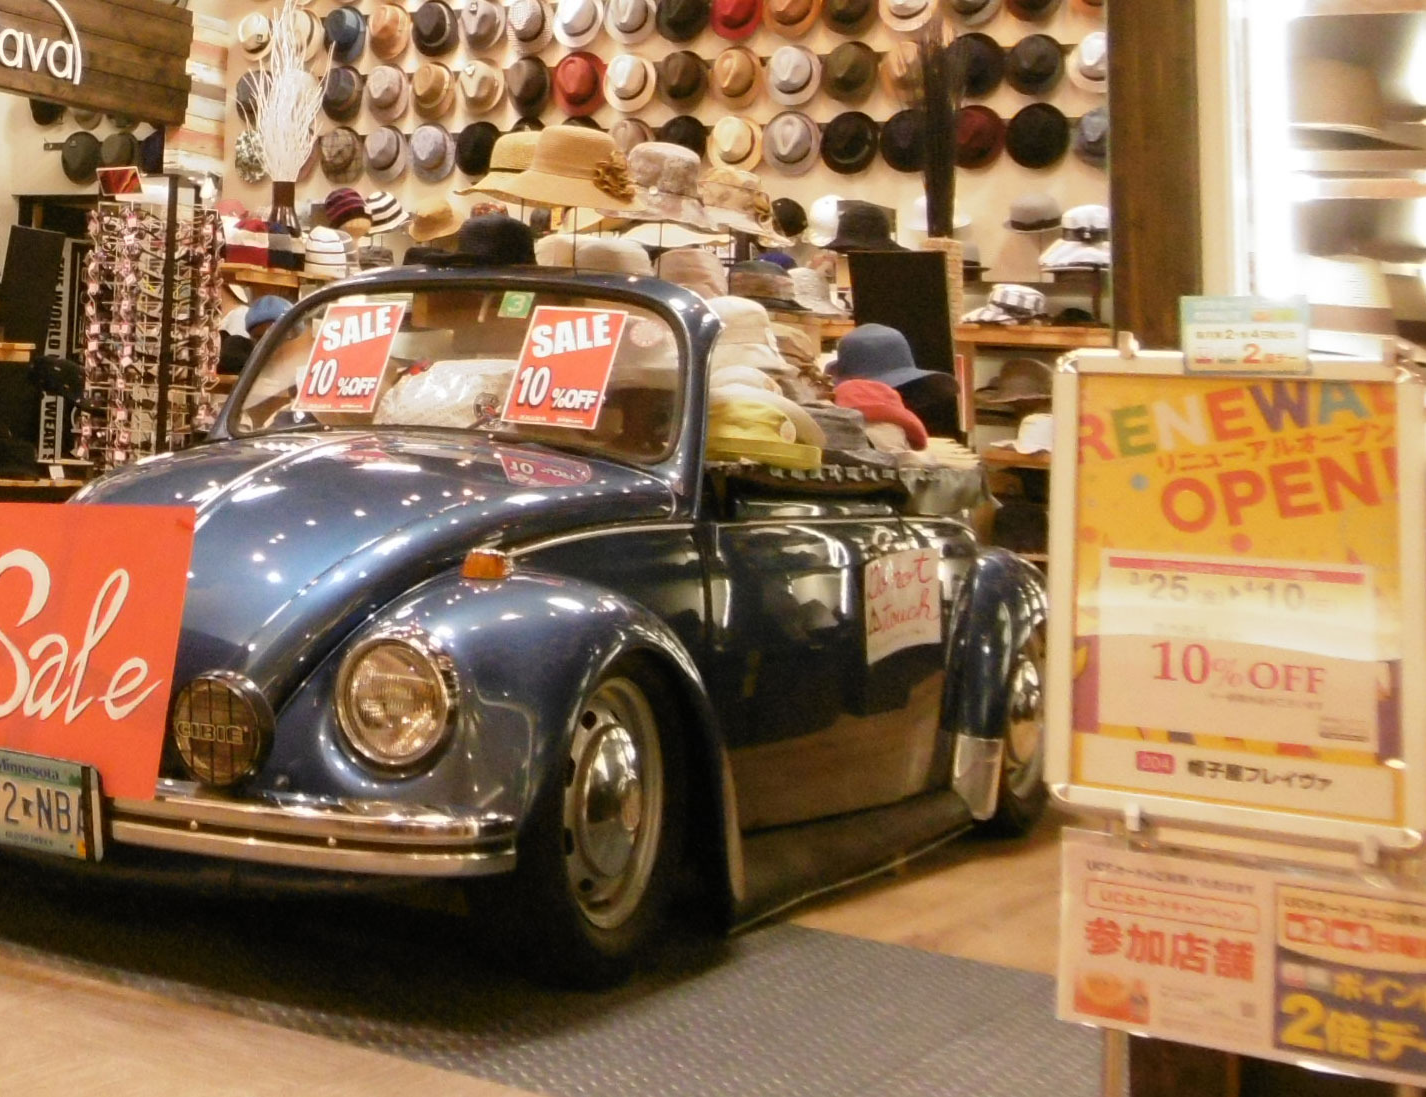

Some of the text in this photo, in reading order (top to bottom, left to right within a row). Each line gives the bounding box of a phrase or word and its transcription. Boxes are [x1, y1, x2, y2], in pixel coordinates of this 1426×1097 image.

[507, 294, 527, 313] 3
[322, 306, 392, 352] SALE
[531, 314, 612, 358] SALE
[307, 358, 338, 396] 10
[517, 366, 551, 406] 10
[1085, 917, 1256, 983] 参加店舗
